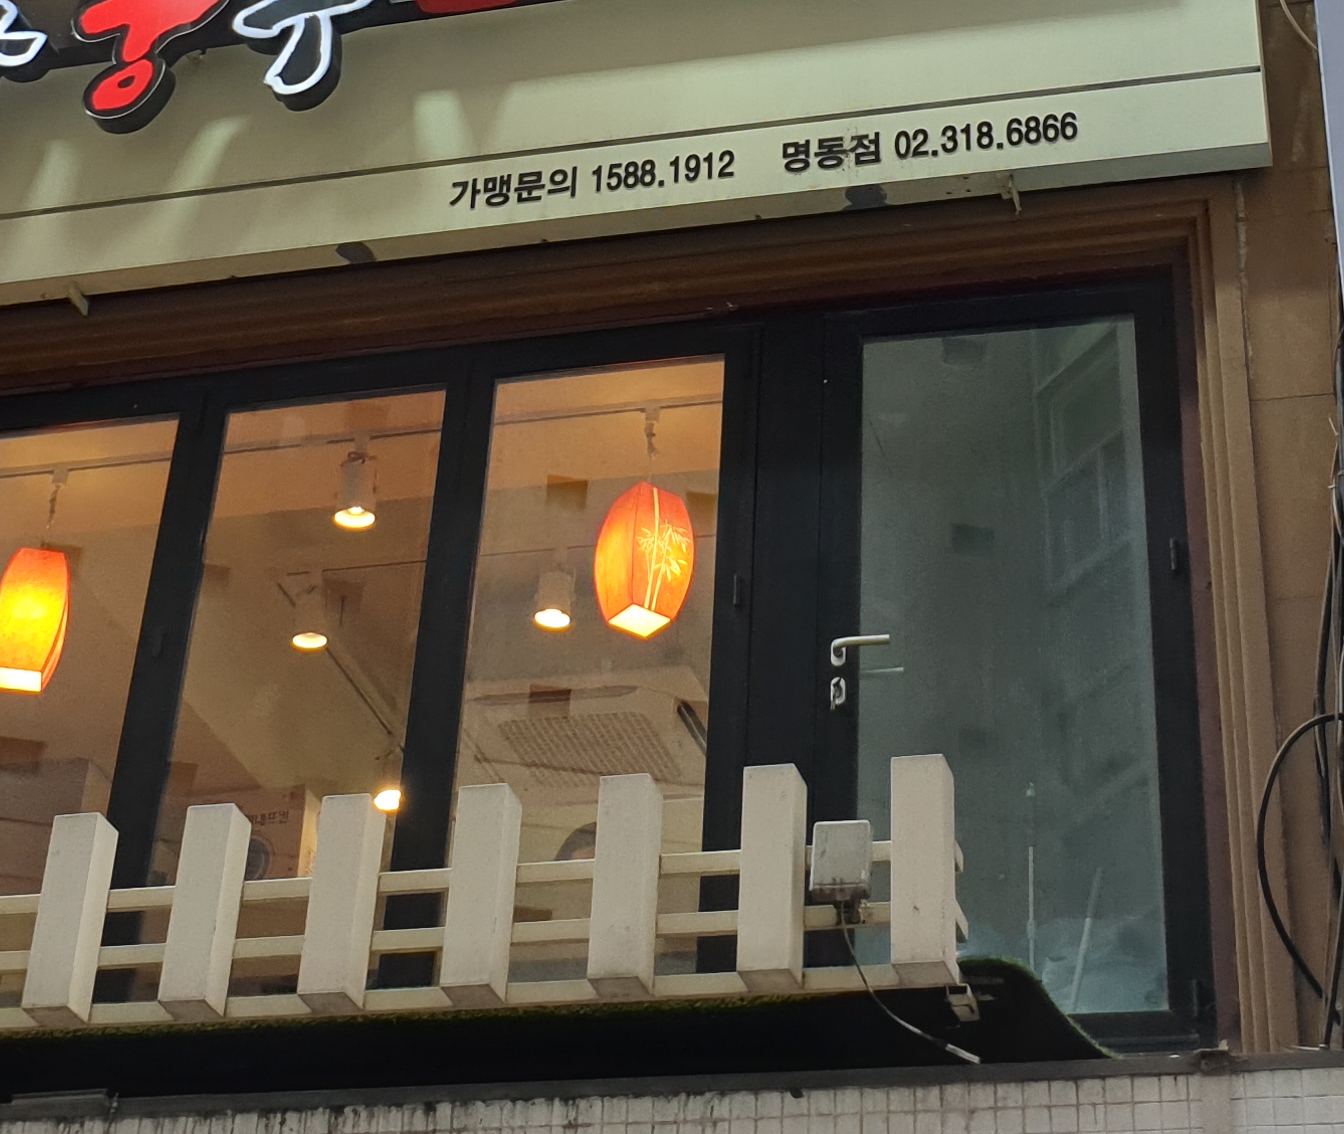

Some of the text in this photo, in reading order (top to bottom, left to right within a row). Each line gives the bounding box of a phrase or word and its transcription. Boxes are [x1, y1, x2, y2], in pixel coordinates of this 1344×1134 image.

[449, 112, 1079, 210] 가맹문의 1588.1912 명동점 02.318.6866
